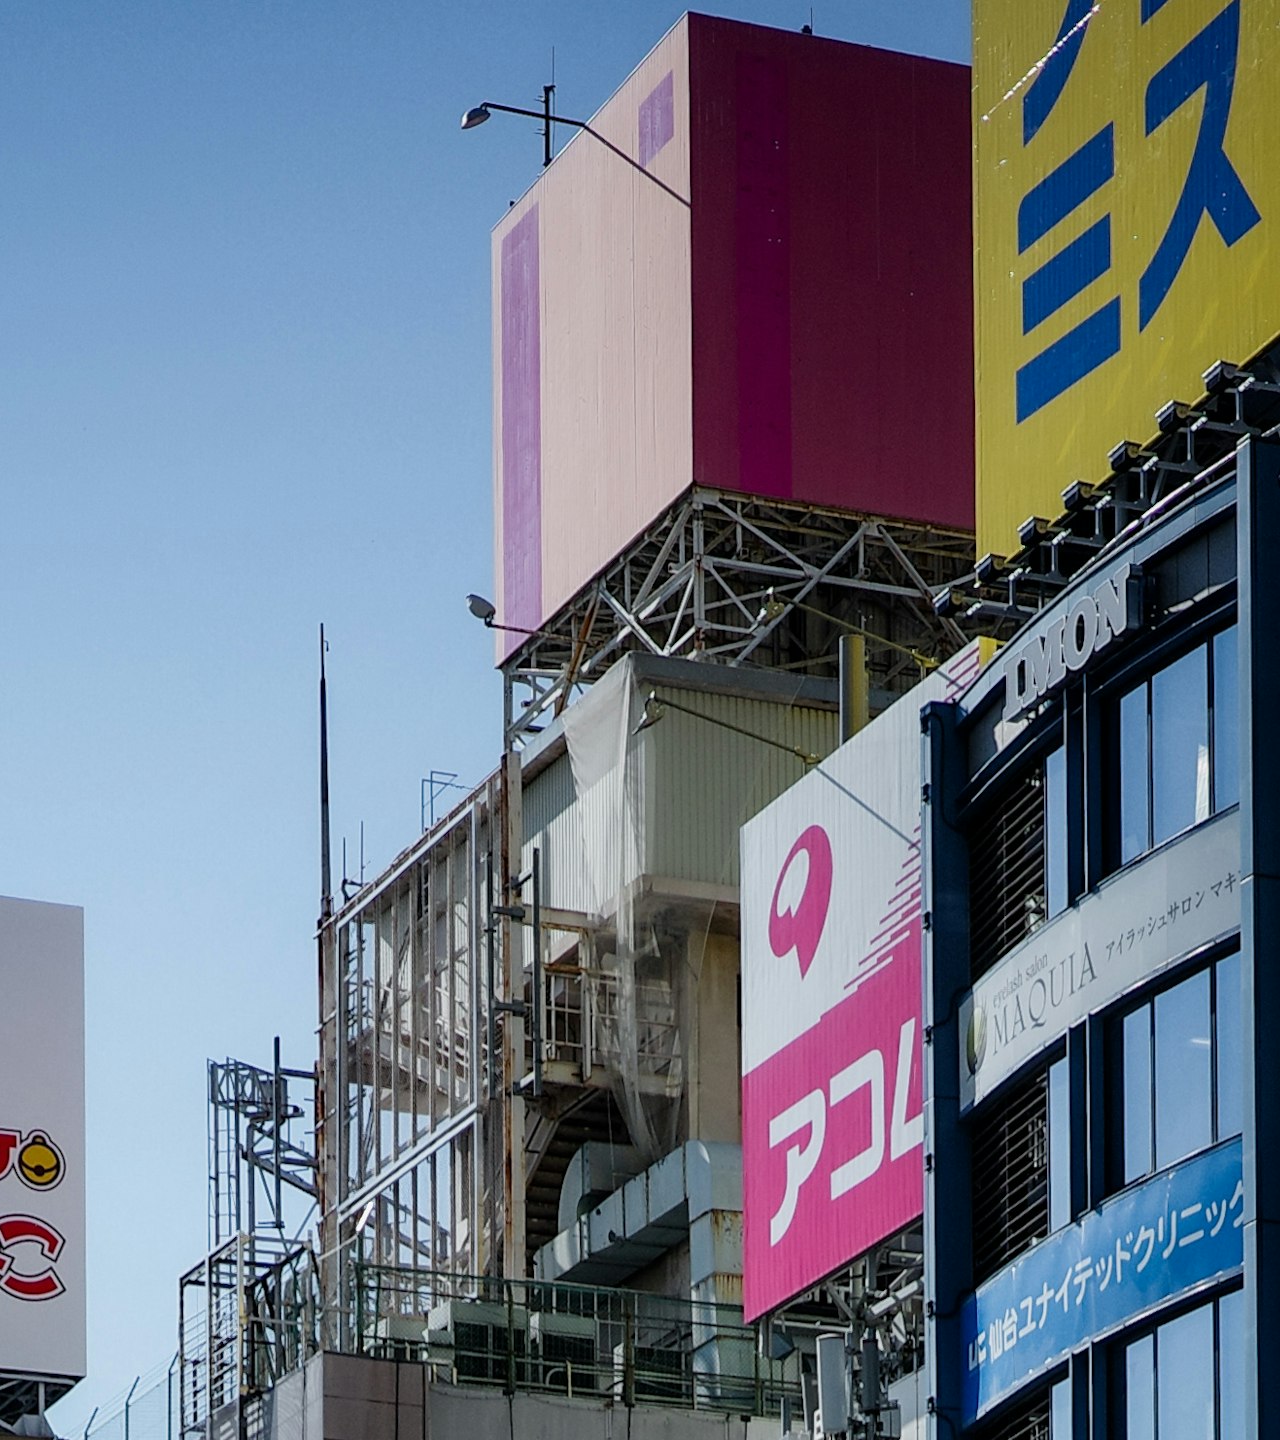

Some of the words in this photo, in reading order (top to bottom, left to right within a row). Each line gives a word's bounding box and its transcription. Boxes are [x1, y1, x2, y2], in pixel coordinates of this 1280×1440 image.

[1001, 563, 1131, 723] IMON
[1025, 953, 1049, 982] salon
[1106, 890, 1205, 960] アイラッシュサロン
[1210, 869, 1241, 895] マキ
[993, 942, 1098, 1057] MAQUIA
[988, 1180, 1244, 1365] 仙台ユナイテッドクリニック
